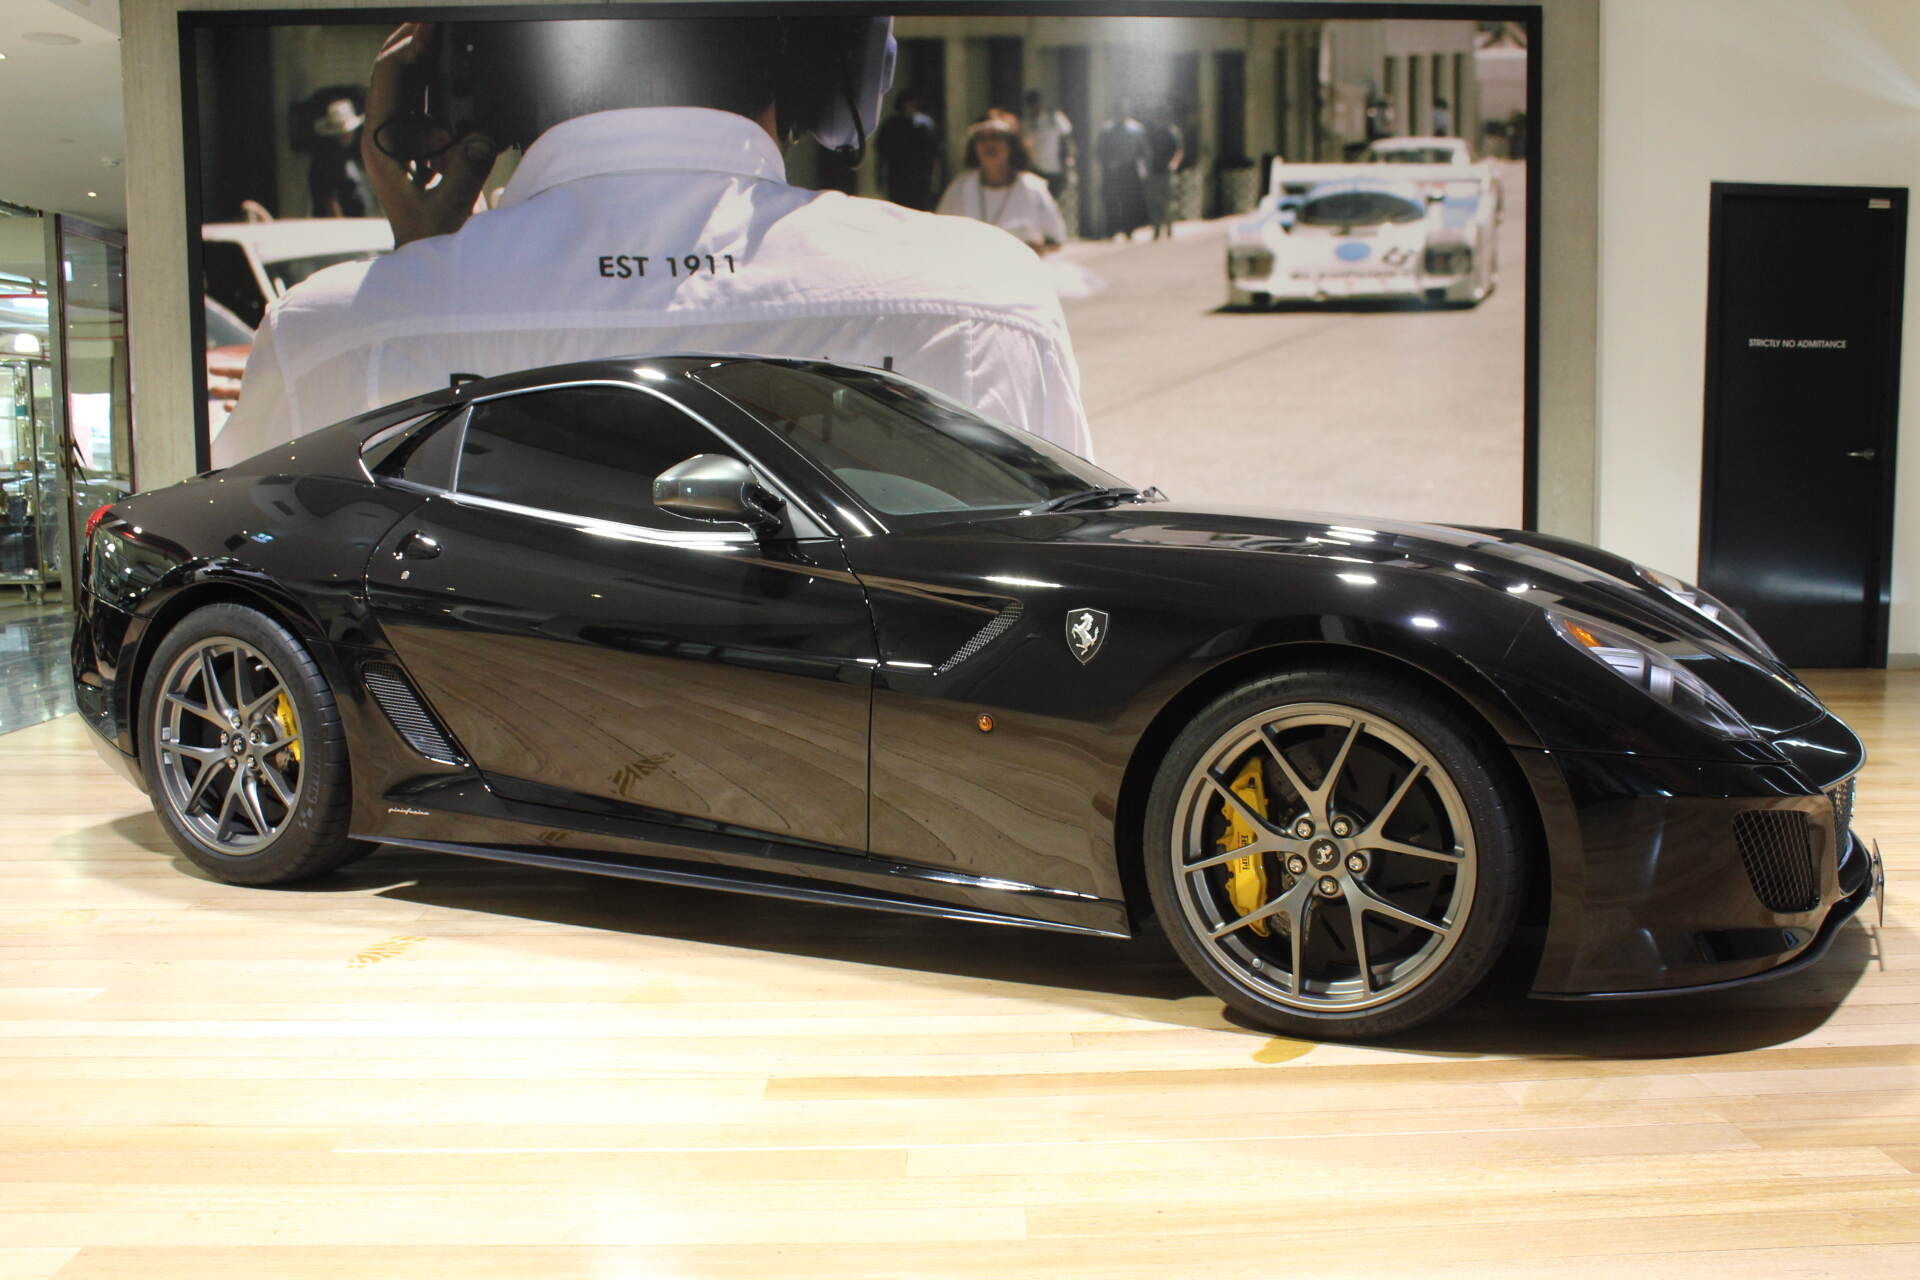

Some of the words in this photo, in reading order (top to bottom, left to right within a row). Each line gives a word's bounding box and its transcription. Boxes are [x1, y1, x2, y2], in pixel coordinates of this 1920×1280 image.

[599, 255, 649, 278] EST
[666, 254, 734, 277] 1911
[1748, 338, 1780, 348] STRICTLY
[1782, 339, 1796, 348] NO
[1797, 339, 1846, 349] ADMITTANCE
